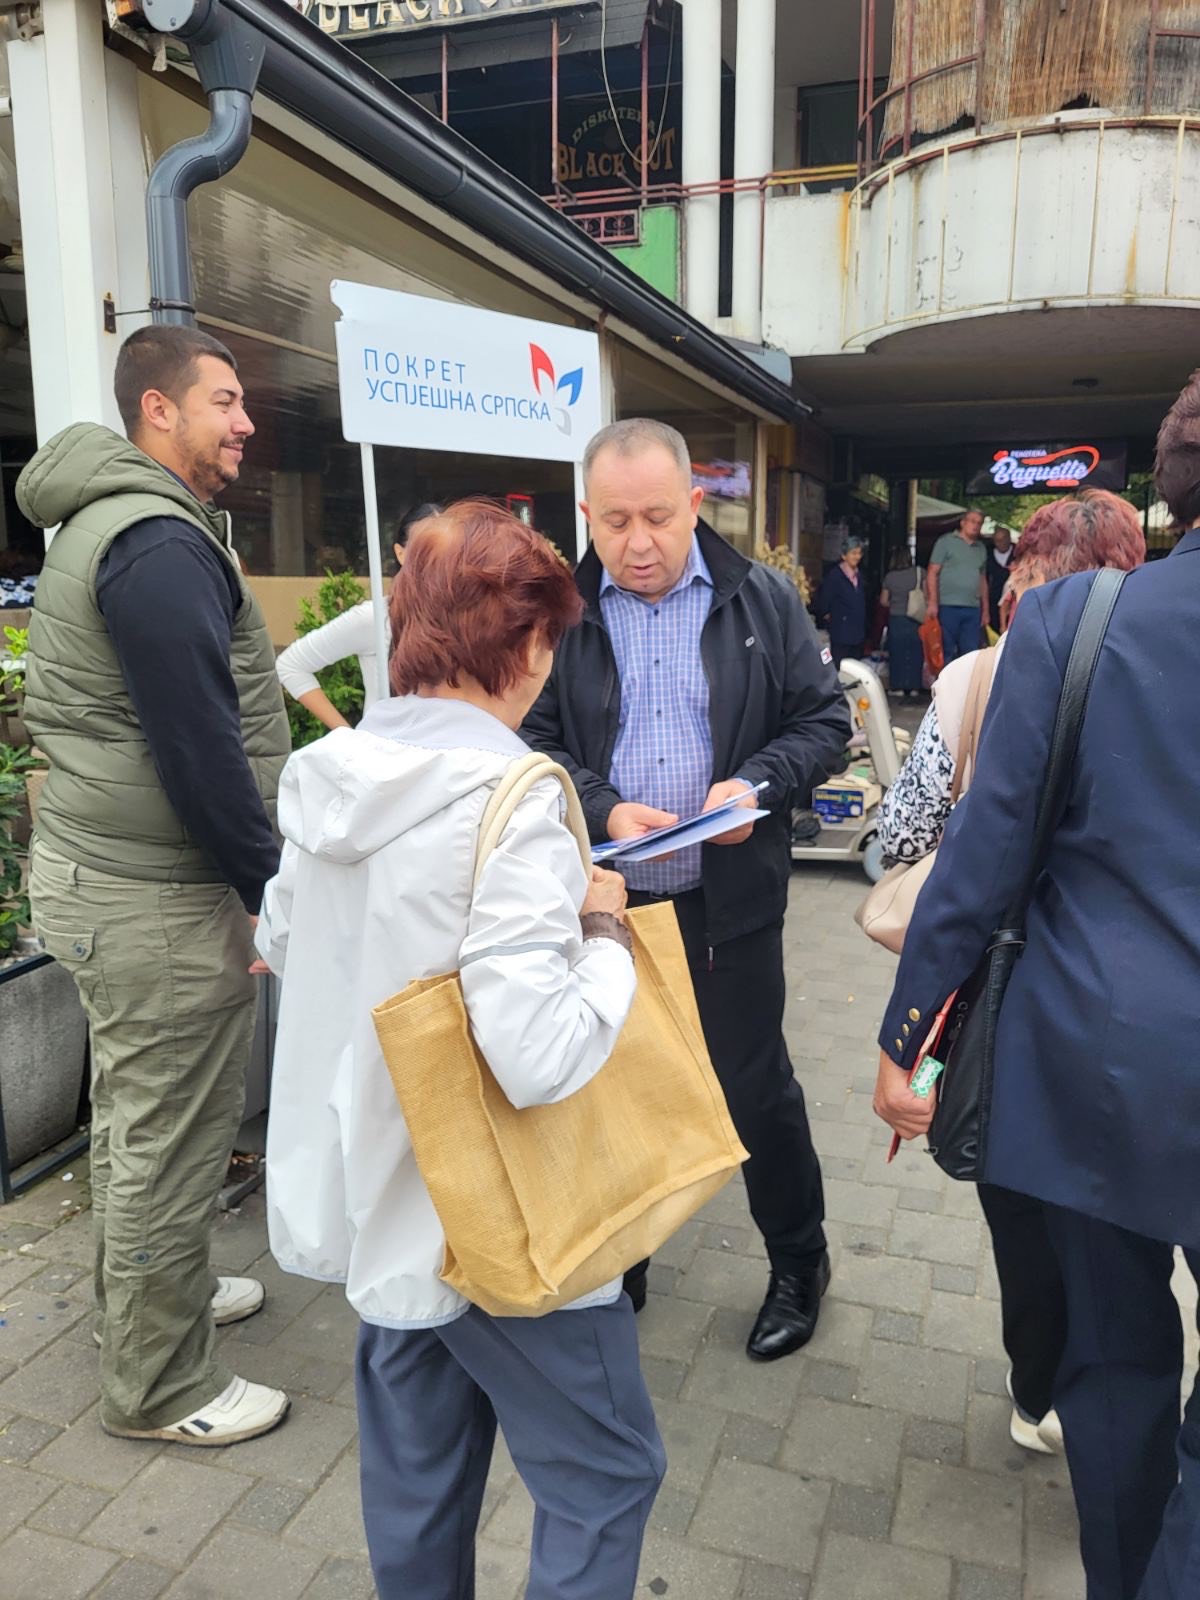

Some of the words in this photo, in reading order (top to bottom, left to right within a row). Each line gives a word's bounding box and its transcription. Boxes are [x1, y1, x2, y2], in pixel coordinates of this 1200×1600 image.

[557, 142, 627, 182] BLACK
[632, 127, 676, 173] OUT
[364, 348, 466, 384] ПОКРЕТ
[366, 378, 477, 413] УСПЈЕШНА
[481, 394, 551, 421] СРПСКА
[990, 456, 1089, 489] Baguette
